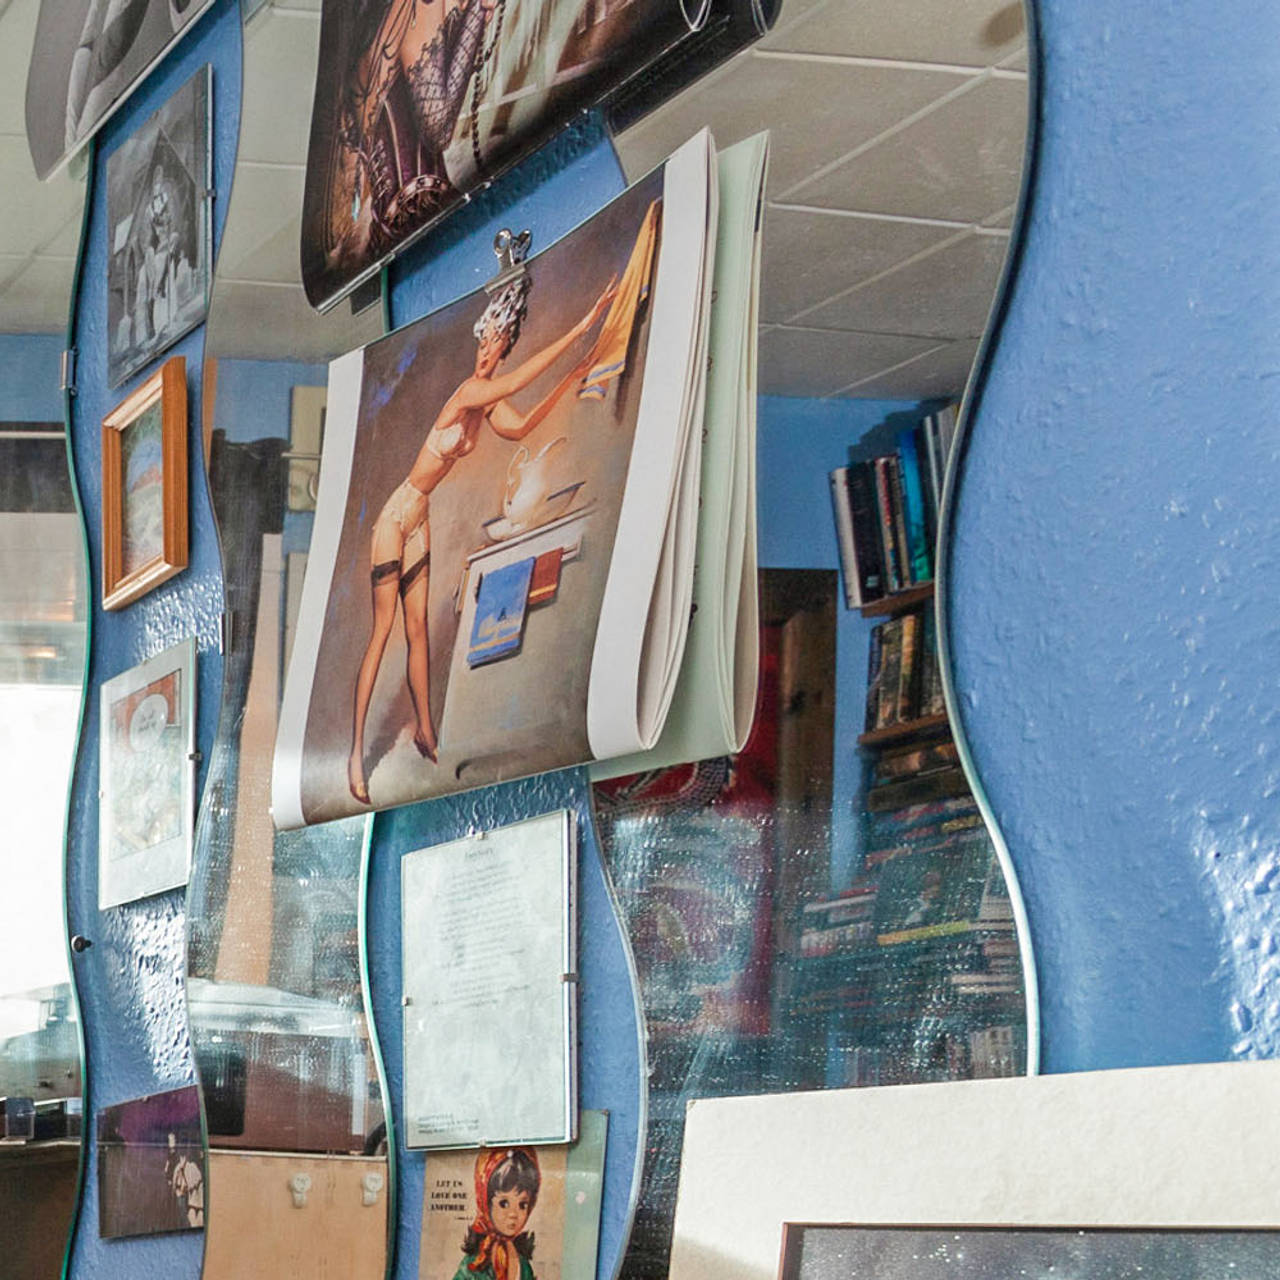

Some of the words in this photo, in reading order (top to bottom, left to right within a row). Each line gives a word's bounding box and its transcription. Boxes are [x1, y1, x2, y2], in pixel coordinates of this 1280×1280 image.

[431, 1191, 450, 1200] LOVE
[452, 1191, 467, 1200] ONE
[431, 1204, 465, 1212] ANOTHER
